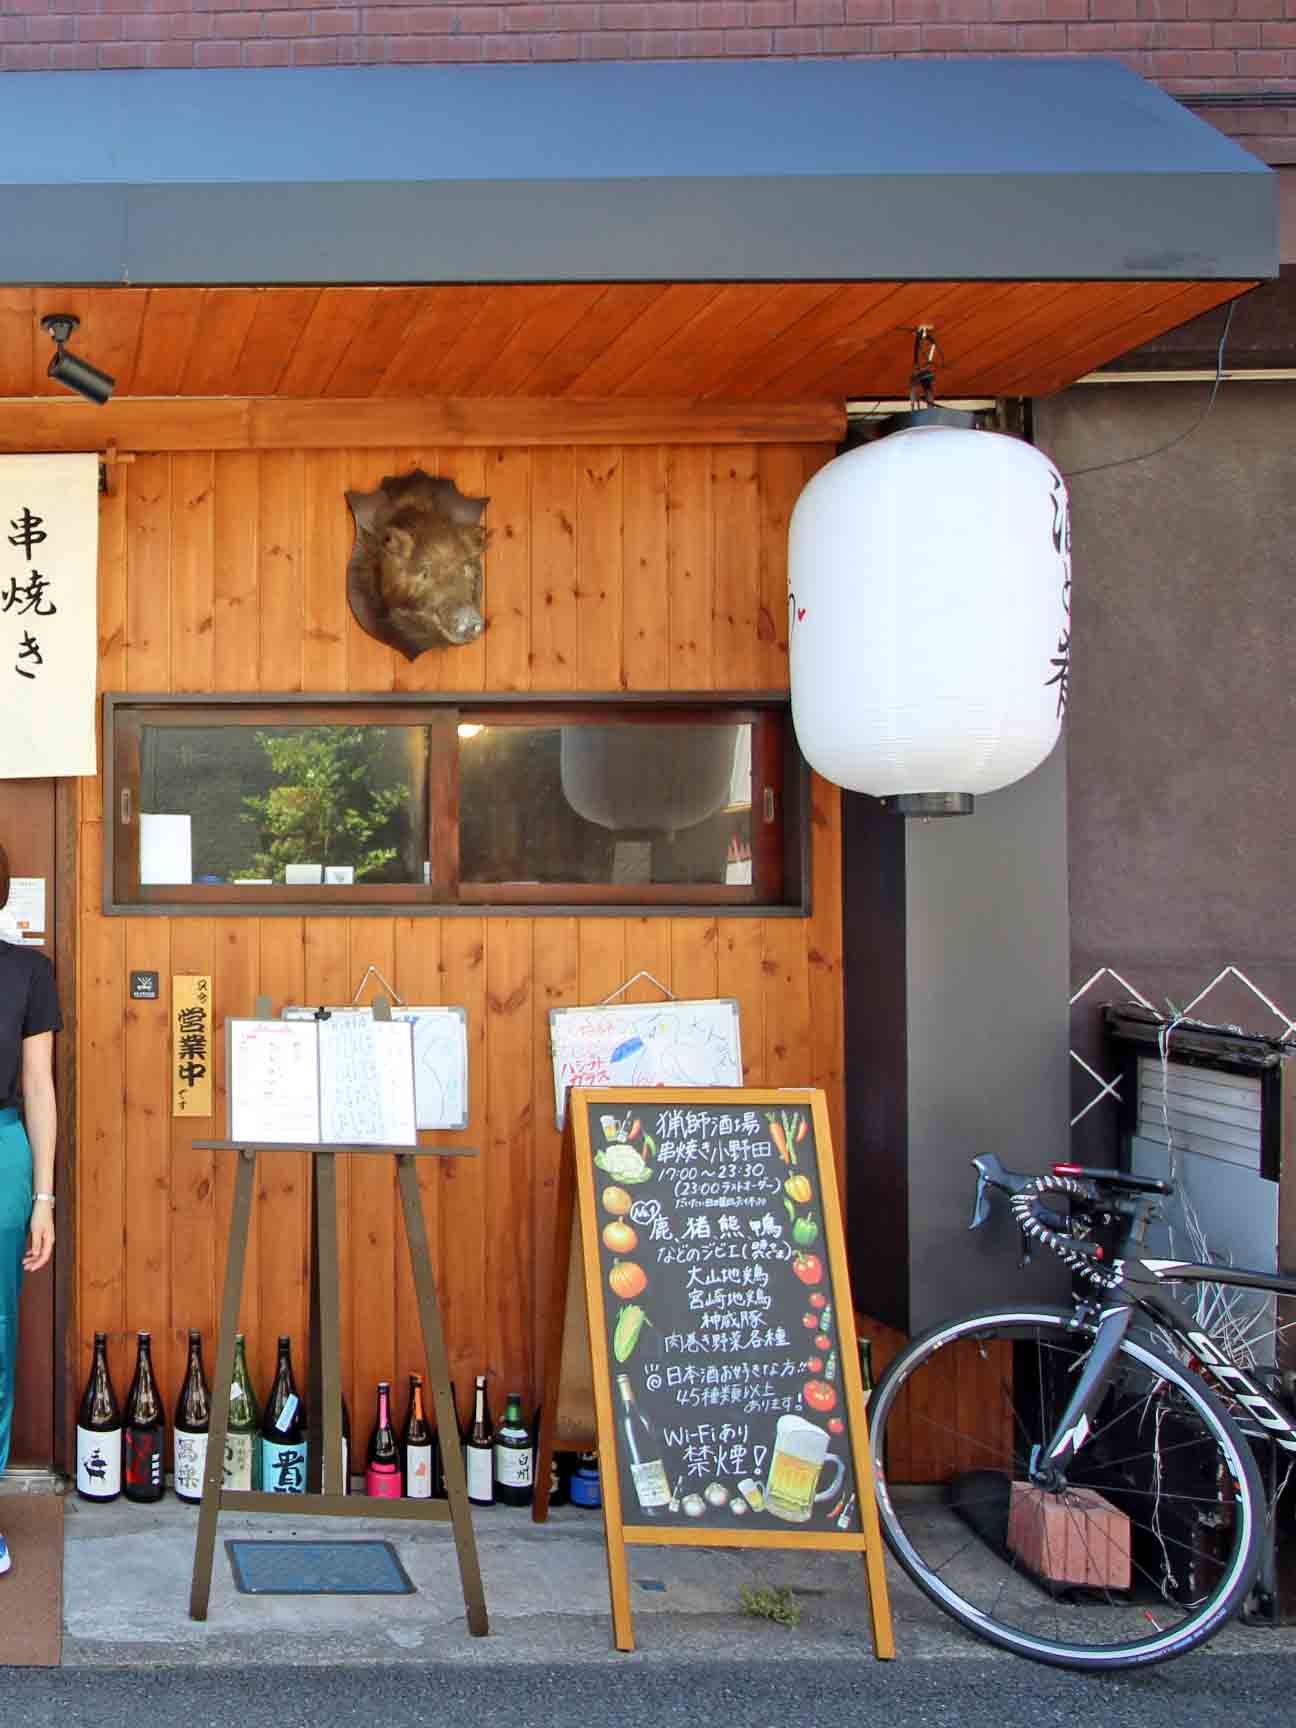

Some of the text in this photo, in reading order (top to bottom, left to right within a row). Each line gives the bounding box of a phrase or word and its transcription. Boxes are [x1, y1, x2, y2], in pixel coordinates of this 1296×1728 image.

[1, 507, 57, 679] 串焼き
[178, 1007, 207, 1087] 営業中
[656, 1109, 760, 1139] 猟師酒場
[656, 1138, 771, 1164] 串焼き小野田
[686, 1264, 769, 1289] 大山地鶏
[688, 1288, 771, 1310] 宮崎地鶏
[676, 1382, 775, 1407] 45種類以上
[1188, 1332, 1296, 1452] SCO
[517, 1454, 529, 1480] 白州
